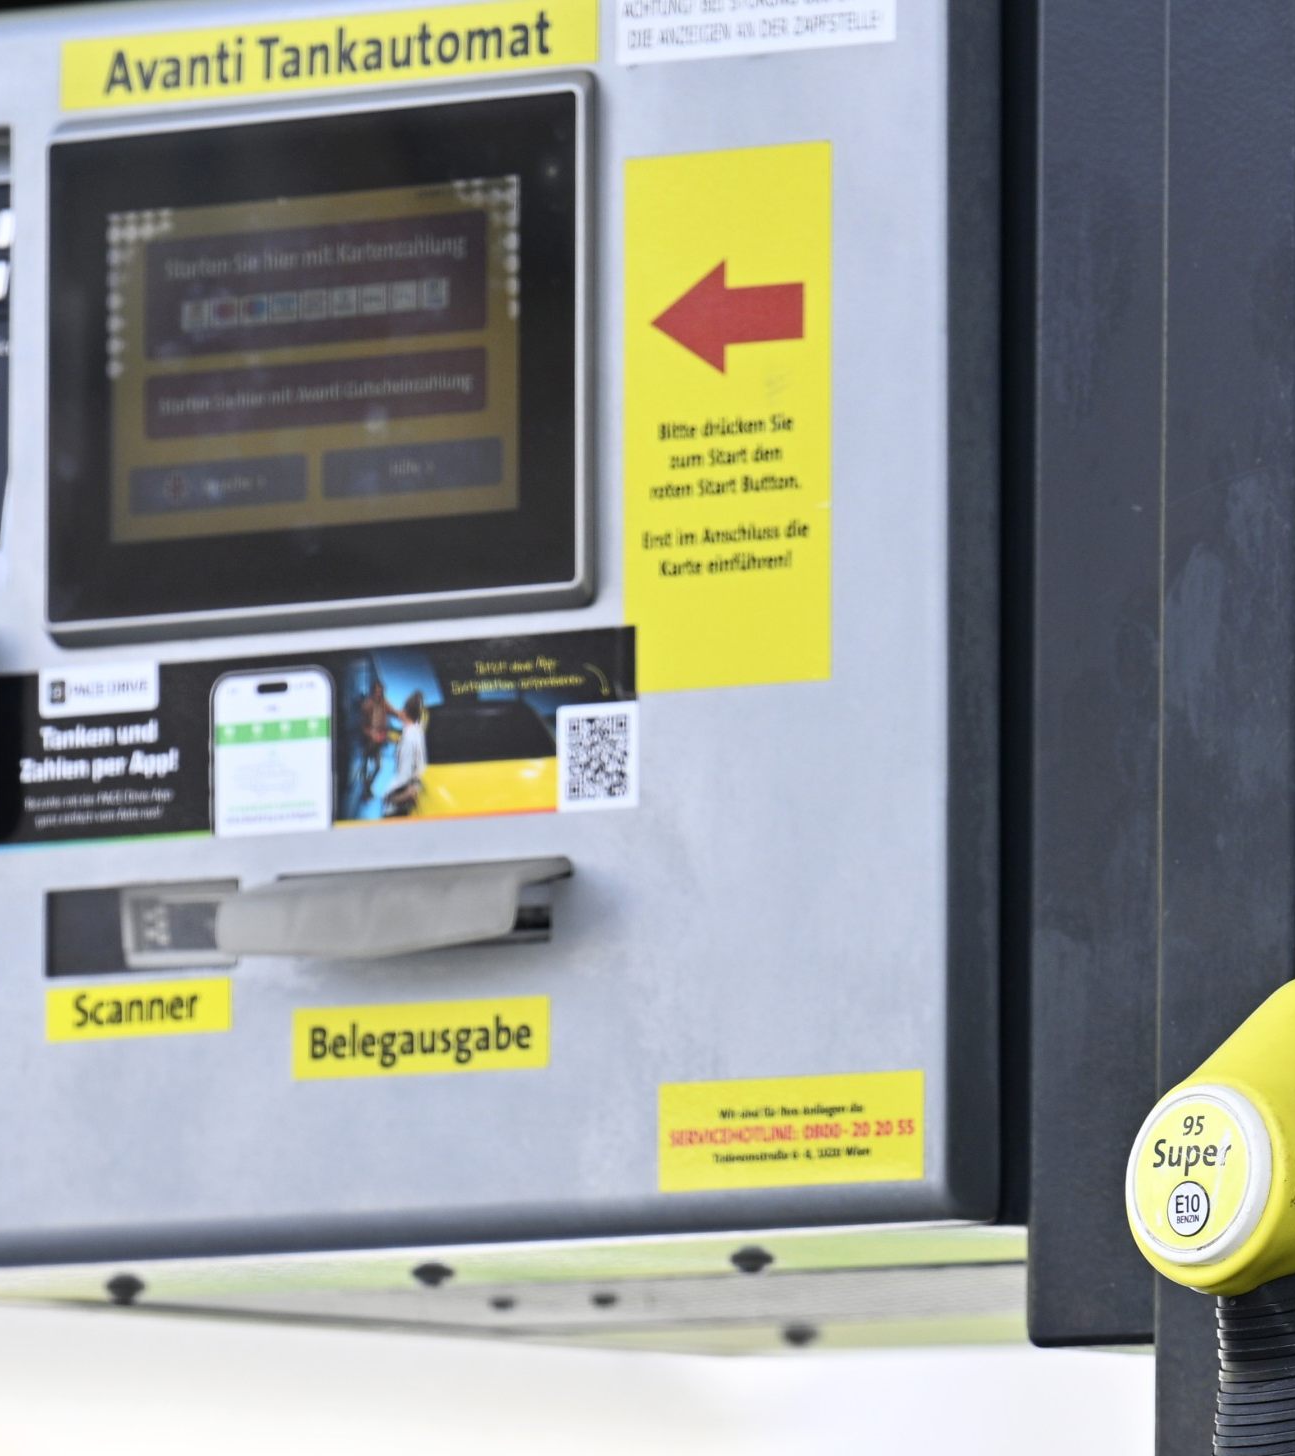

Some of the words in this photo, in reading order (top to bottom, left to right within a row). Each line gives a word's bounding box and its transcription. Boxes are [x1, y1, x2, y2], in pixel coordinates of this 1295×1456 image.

[103, 37, 243, 94] Avanti
[258, 10, 551, 81] Tankautomat
[658, 422, 695, 440] Bitte
[702, 417, 765, 437] drücken
[771, 413, 794, 432] Sie
[670, 454, 703, 469] zum
[709, 447, 747, 466] Start
[753, 445, 782, 462] den
[650, 482, 693, 500] roten
[698, 478, 736, 497] Start
[785, 519, 810, 539] die
[660, 559, 702, 577] Karte
[39, 722, 115, 751] Tanken
[116, 718, 158, 746] und
[19, 755, 92, 784] Zahlen
[92, 756, 128, 784] per
[72, 992, 199, 1028] Scanner
[308, 1014, 533, 1068] Belegausgabe
[852, 1121, 870, 1138] 20
[874, 1119, 893, 1137] 20
[898, 1118, 915, 1136] 55
[1182, 1115, 1205, 1136] 95
[1153, 1139, 1232, 1176] Super
[1174, 1193, 1201, 1215] E10
[1176, 1215, 1200, 1225] BENZIN
